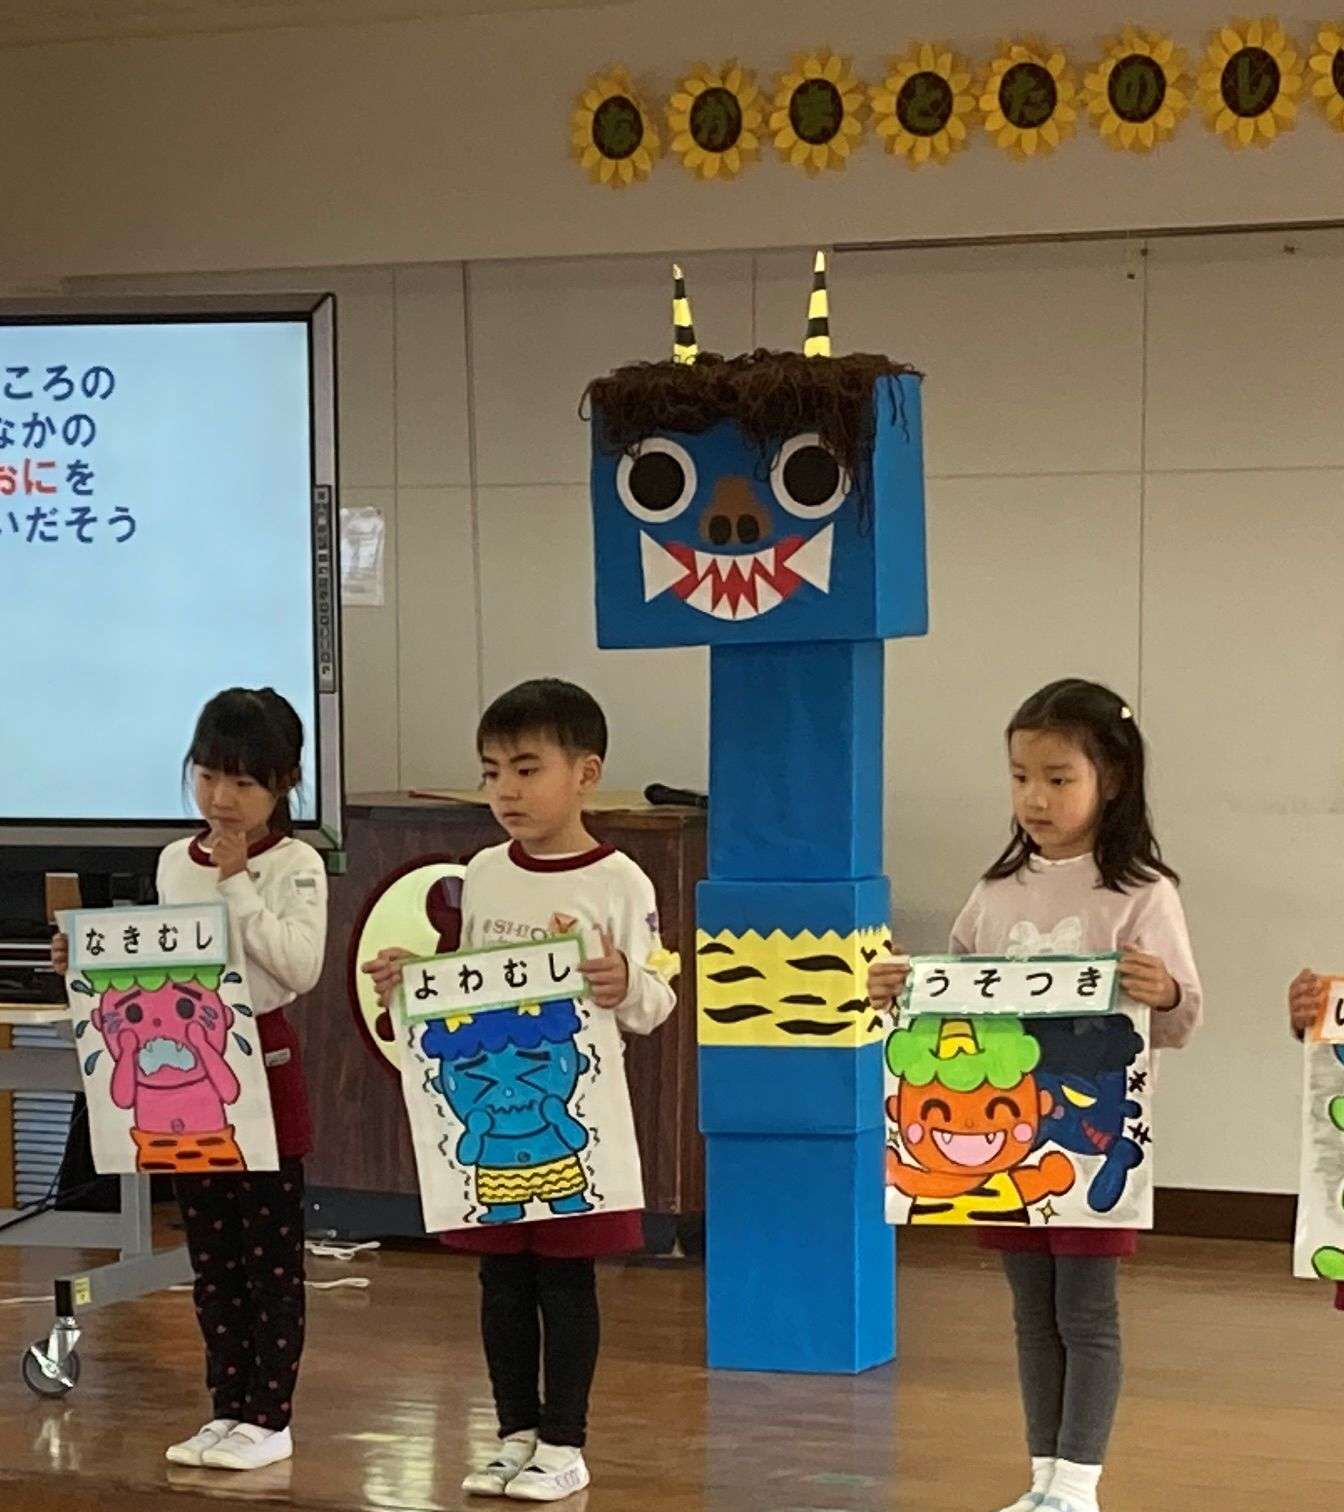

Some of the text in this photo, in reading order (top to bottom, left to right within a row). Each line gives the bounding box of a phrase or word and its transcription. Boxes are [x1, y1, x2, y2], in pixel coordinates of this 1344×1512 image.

[85, 922, 214, 956] なきむし
[414, 952, 572, 1001] よわむし
[925, 966, 1103, 998] うそつき
